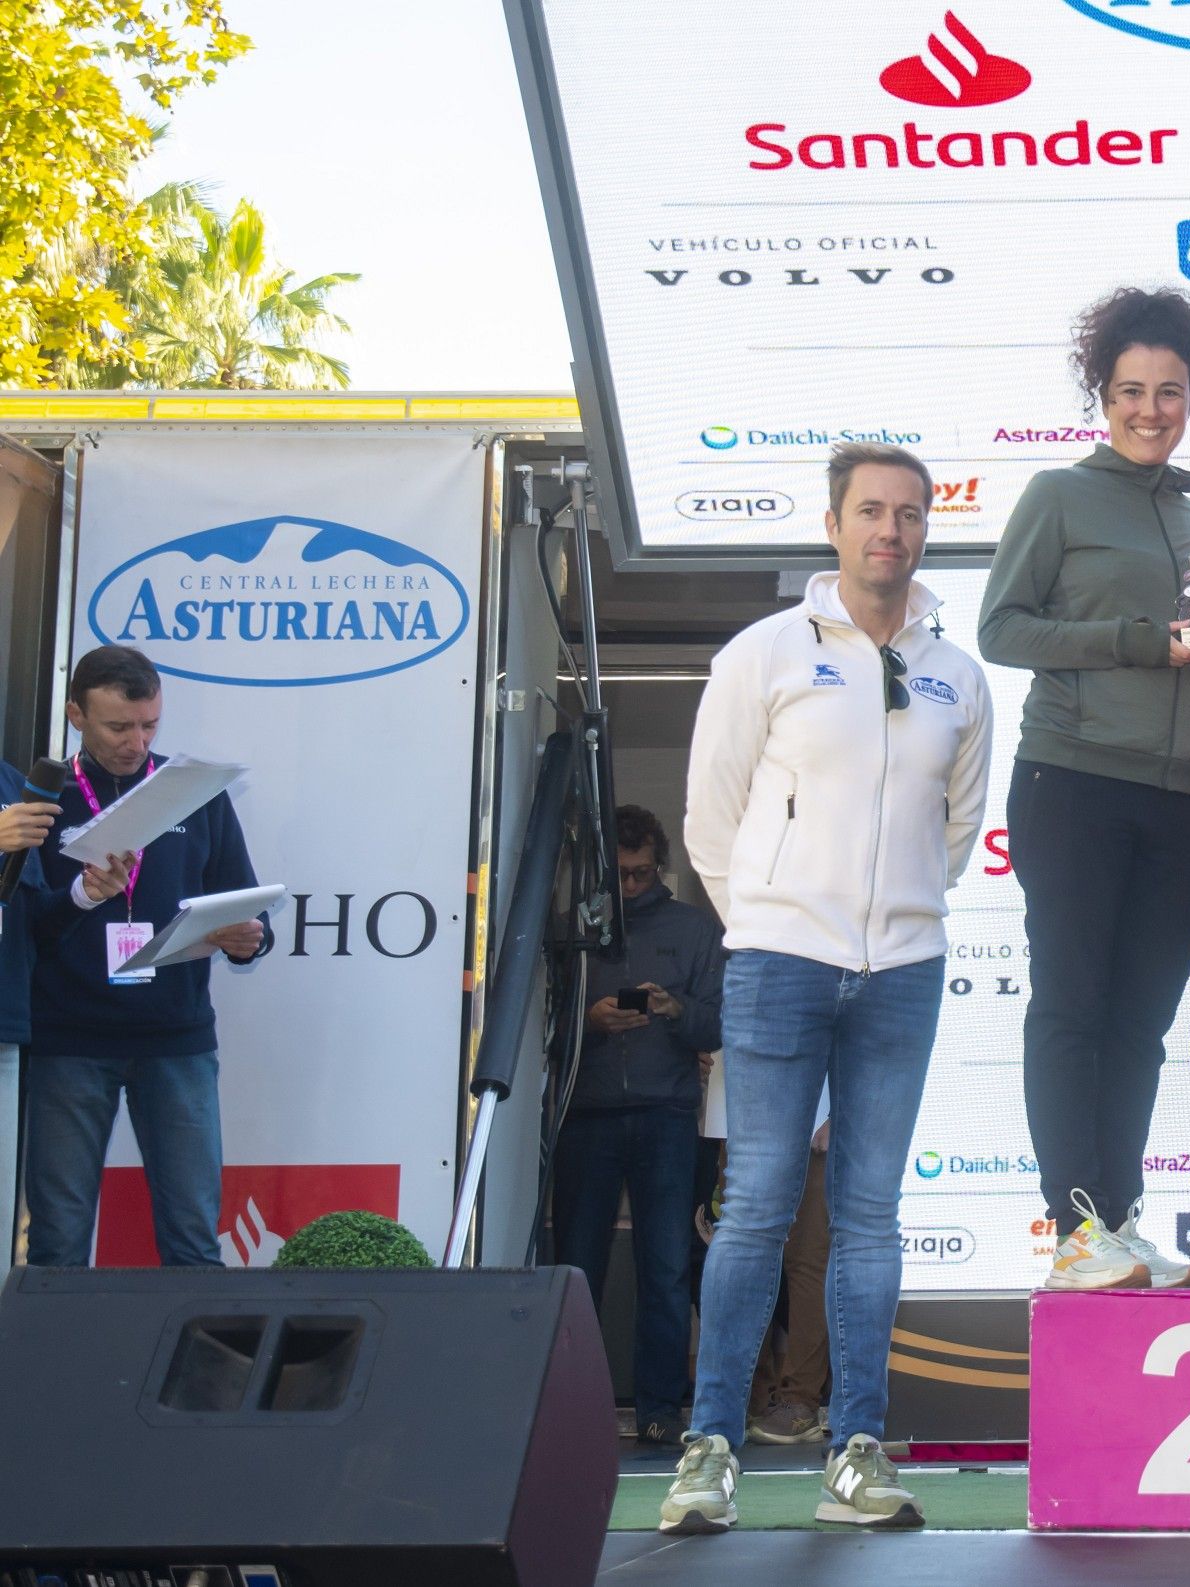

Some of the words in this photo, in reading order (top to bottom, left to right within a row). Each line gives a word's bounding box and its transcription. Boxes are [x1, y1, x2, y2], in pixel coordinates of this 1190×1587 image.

[744, 119, 1178, 170] Santander
[648, 236, 802, 251] VEHÍCULO
[817, 236, 939, 251] OFICIAL
[643, 267, 955, 287] VOLVO
[692, 498, 777, 516] ziaja
[180, 575, 297, 590] CENTRAL
[312, 575, 431, 590] LECHERA
[117, 577, 442, 642] ASTURIANA
[984, 828, 1011, 876] S
[256, 891, 438, 959] HO
[949, 978, 1020, 995] OL
[949, 1155, 1039, 1174] Daiichi-Sa
